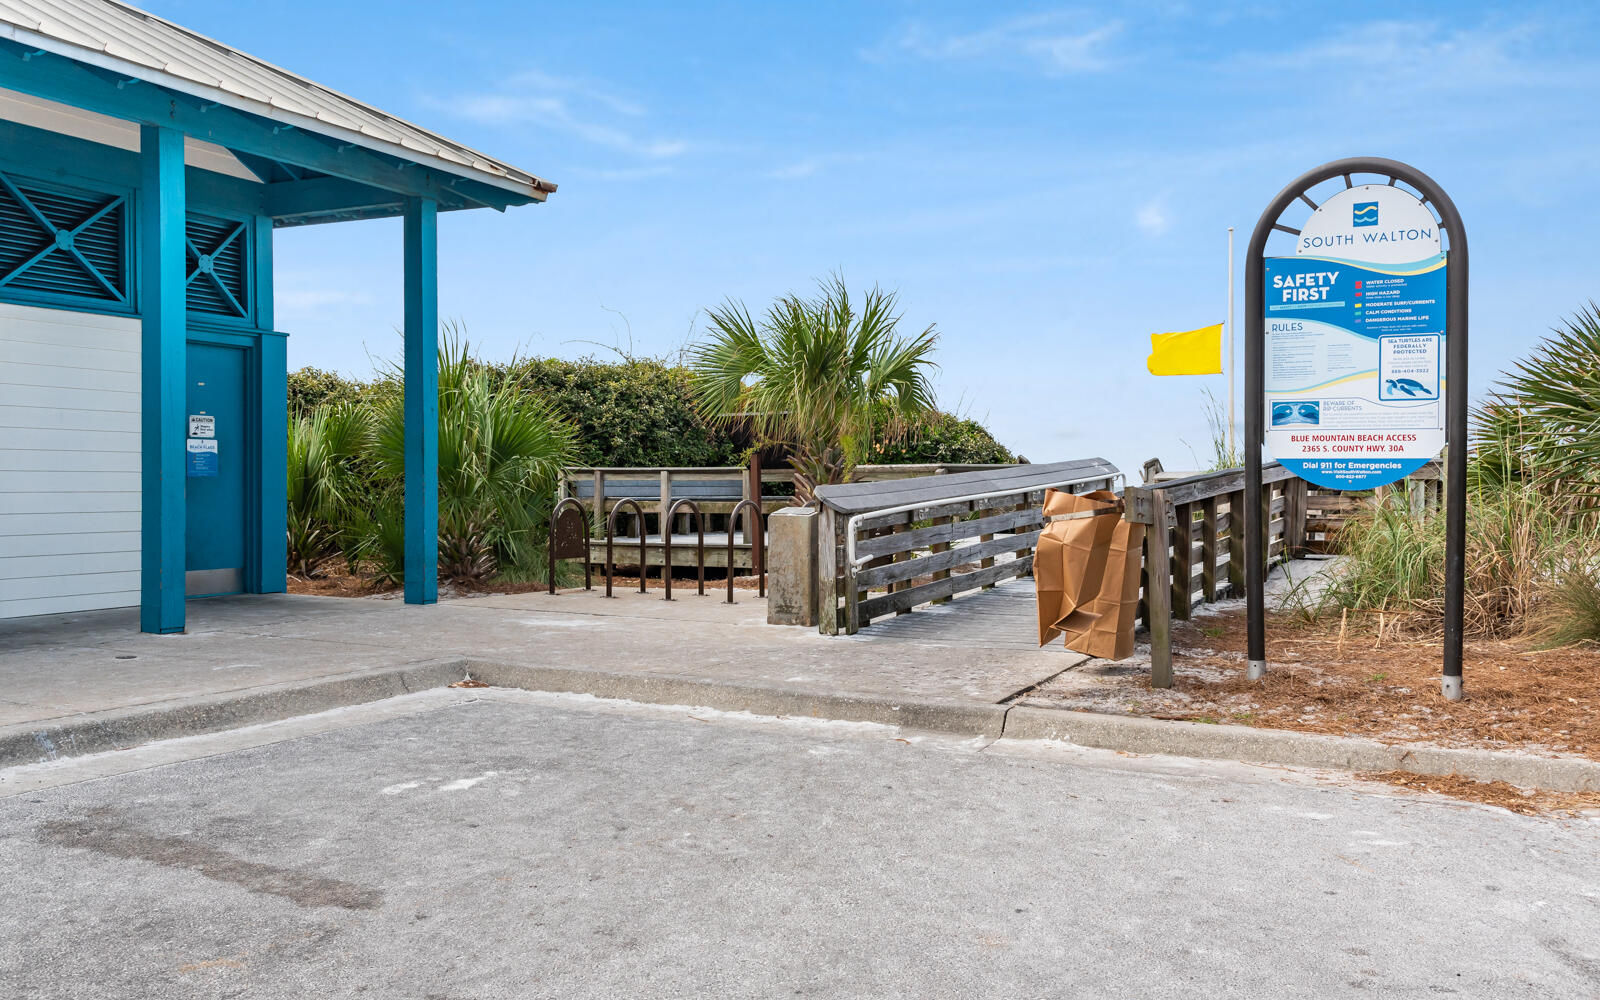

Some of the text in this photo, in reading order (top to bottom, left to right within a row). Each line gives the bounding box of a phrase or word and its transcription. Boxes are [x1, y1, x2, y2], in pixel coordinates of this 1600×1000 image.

[1303, 229, 1432, 248] SOUTH WALTON
[1273, 271, 1340, 288] SAFETY
[1282, 286, 1330, 302] FIRST
[1271, 322, 1303, 332] RULES
[1357, 434, 1383, 442] BEACH
[1302, 445, 1321, 453] 2365
[1323, 445, 1330, 453] S.
[1348, 462, 1402, 471] Emergencies
